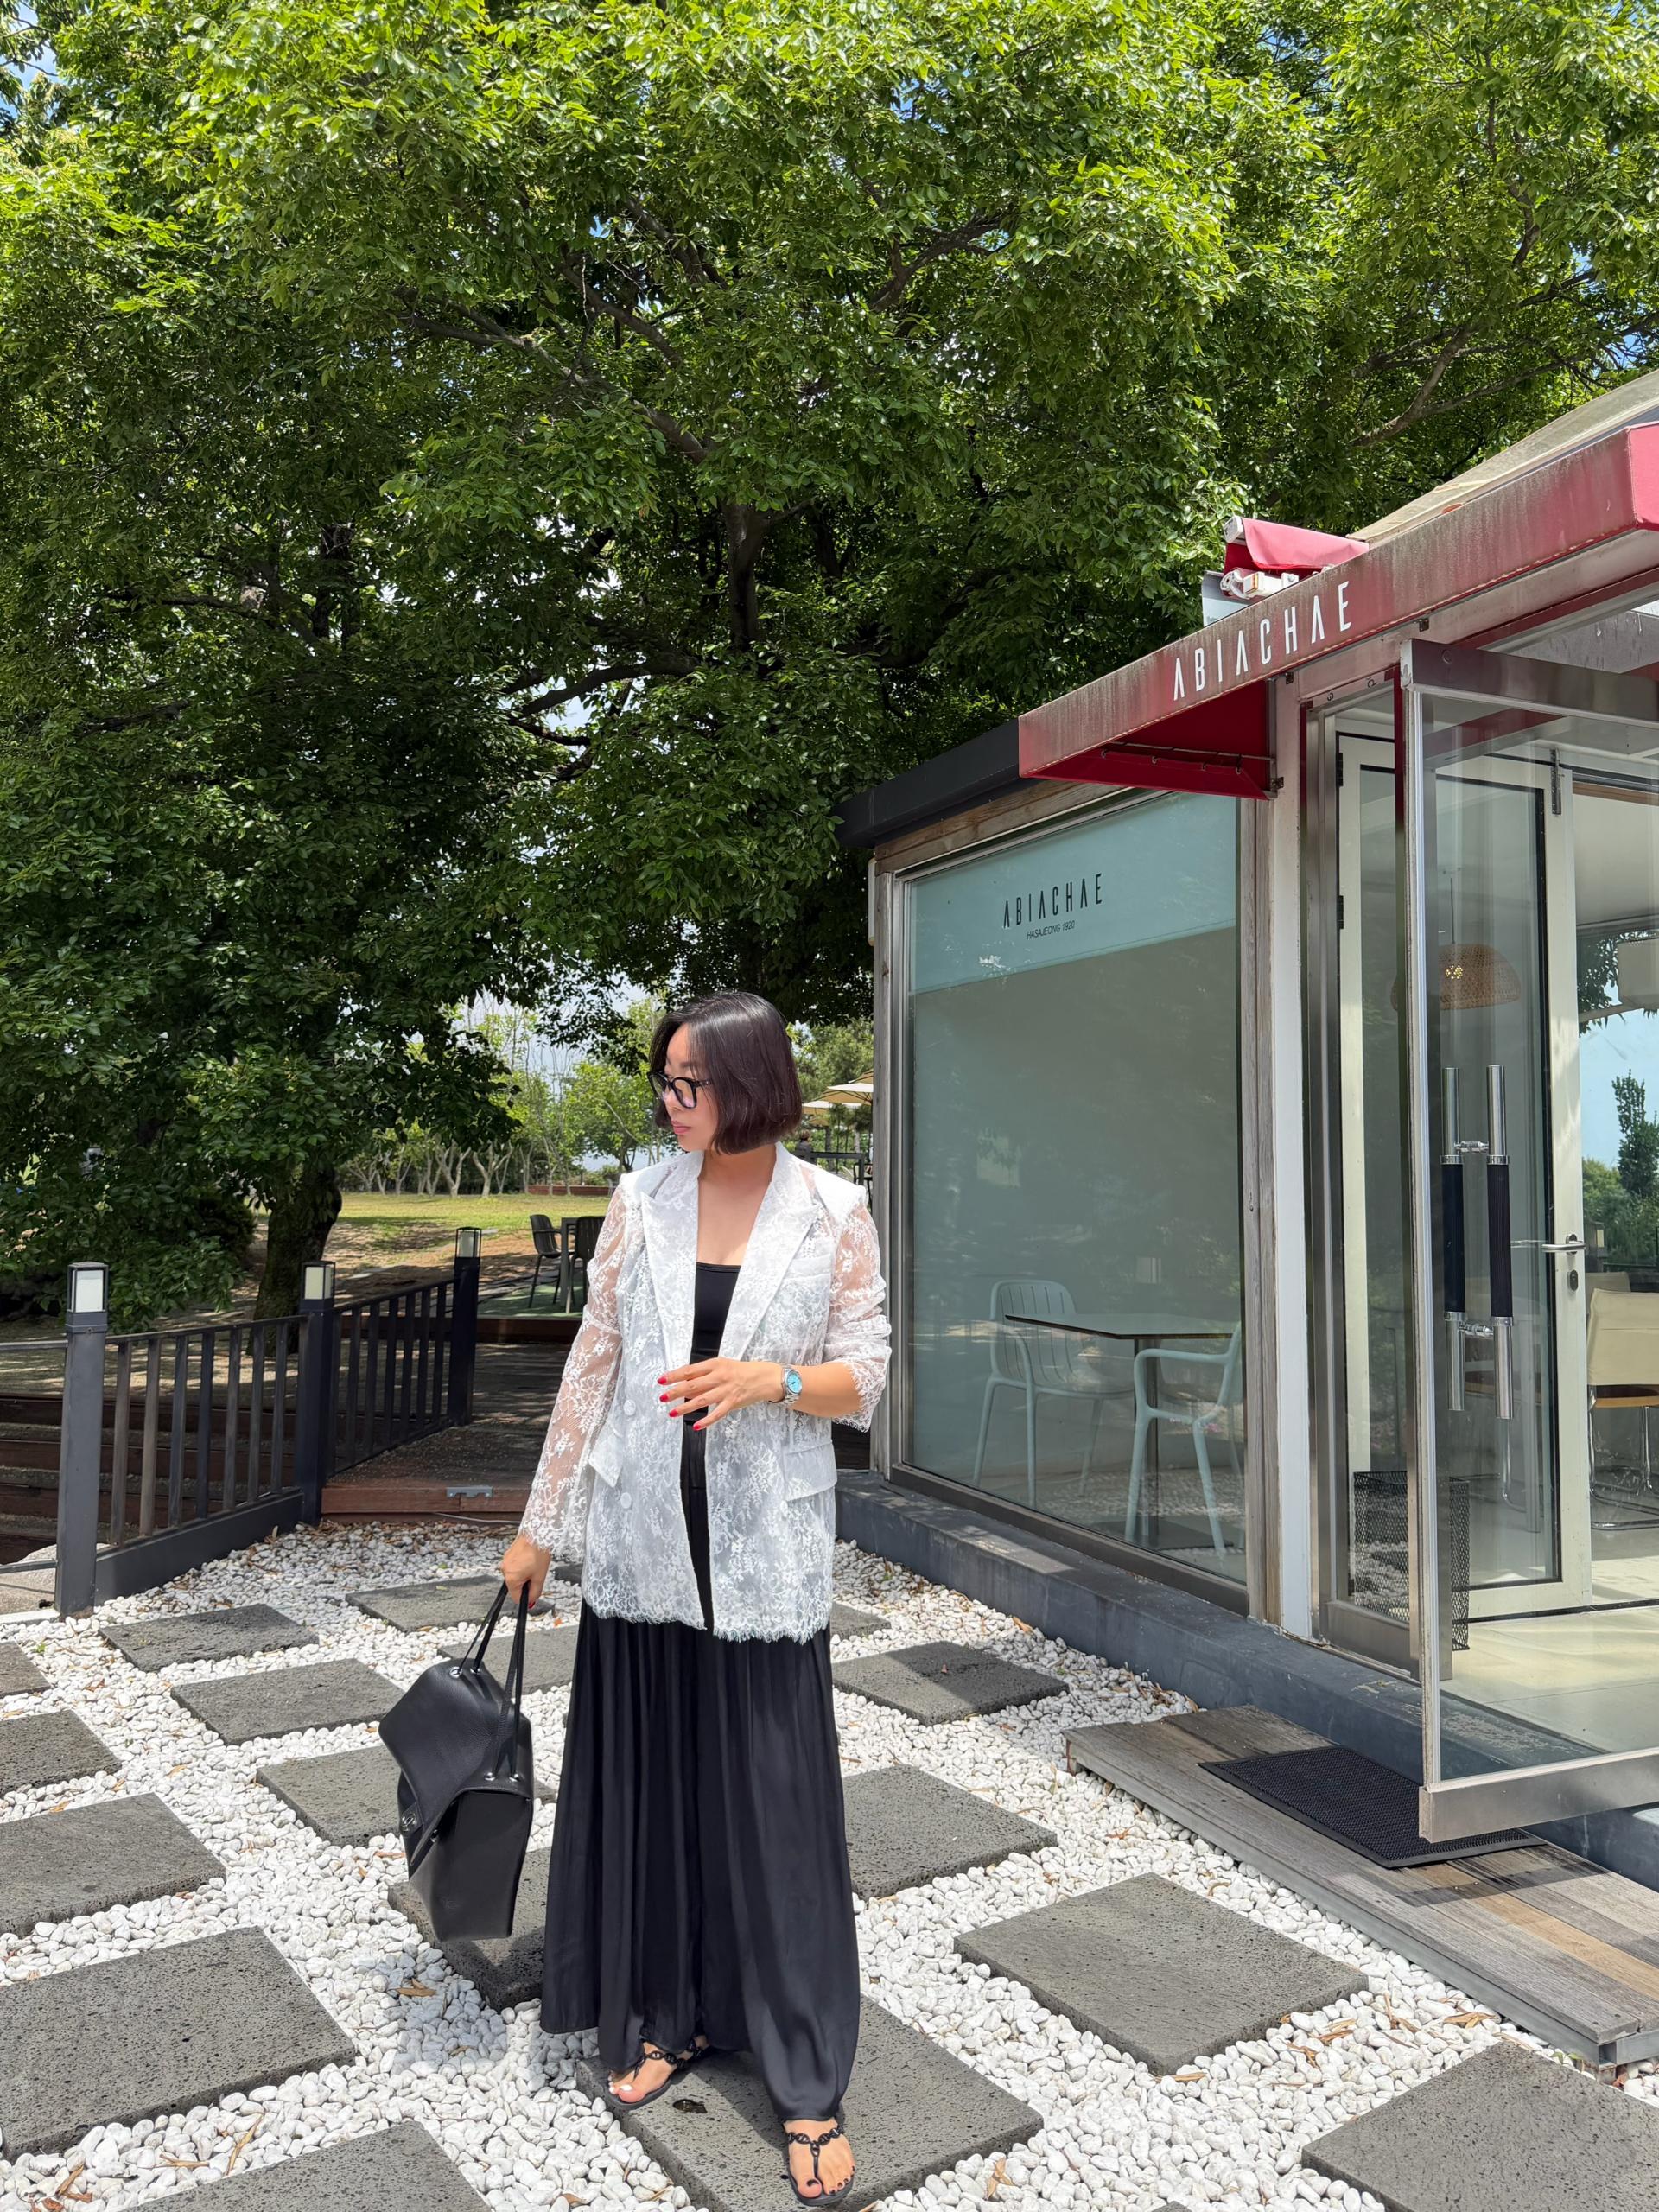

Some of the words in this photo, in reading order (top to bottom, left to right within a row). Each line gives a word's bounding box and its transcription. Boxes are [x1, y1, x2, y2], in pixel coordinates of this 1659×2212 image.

[1173, 581, 1351, 701] ABIACHAE
[1003, 873, 1102, 928] ABIACHAE
[1027, 924, 1061, 940] HASAJEONG
[1062, 920, 1076, 931] 1920
